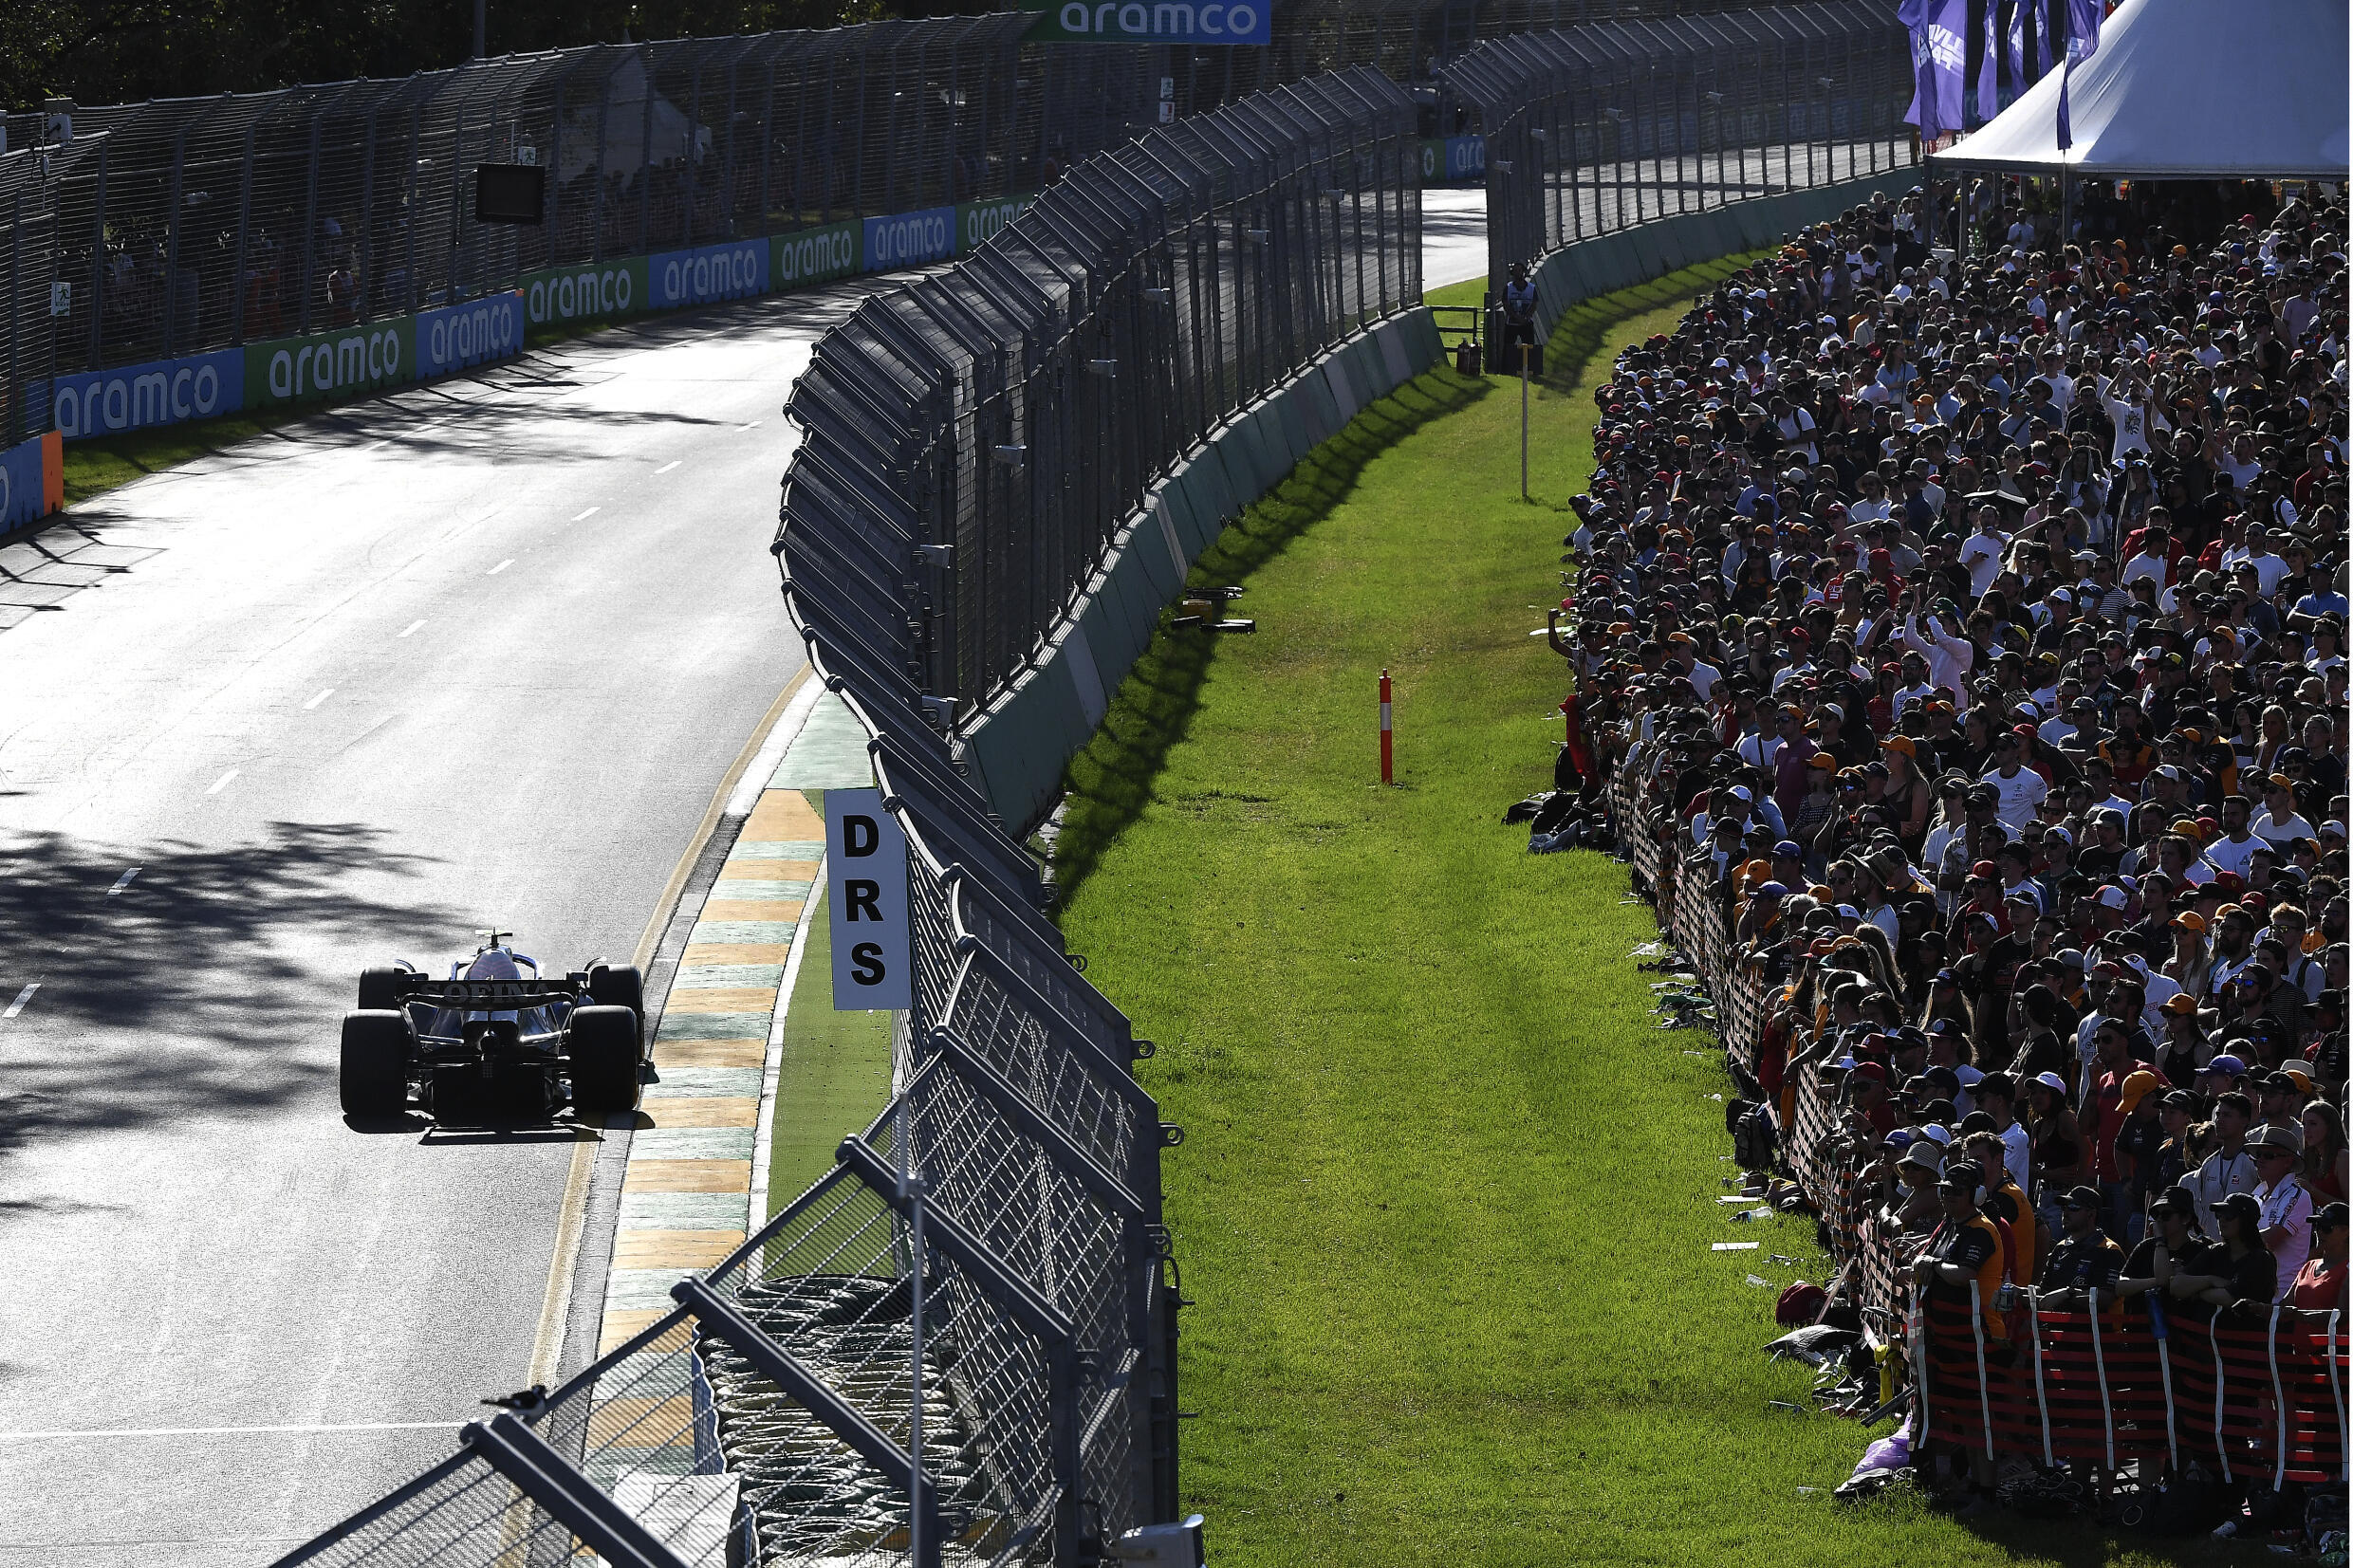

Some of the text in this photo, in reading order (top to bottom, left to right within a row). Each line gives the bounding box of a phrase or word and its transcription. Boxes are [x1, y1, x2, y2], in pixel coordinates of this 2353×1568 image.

[1060, 2, 1257, 35] aramco
[782, 229, 852, 281] aramco
[875, 216, 945, 261] aramco
[529, 268, 632, 323] aramco
[665, 249, 757, 301] aramco
[431, 303, 512, 365] aramco
[269, 328, 399, 397] aramco
[54, 364, 218, 437] aramco
[843, 814, 885, 987] DRS
